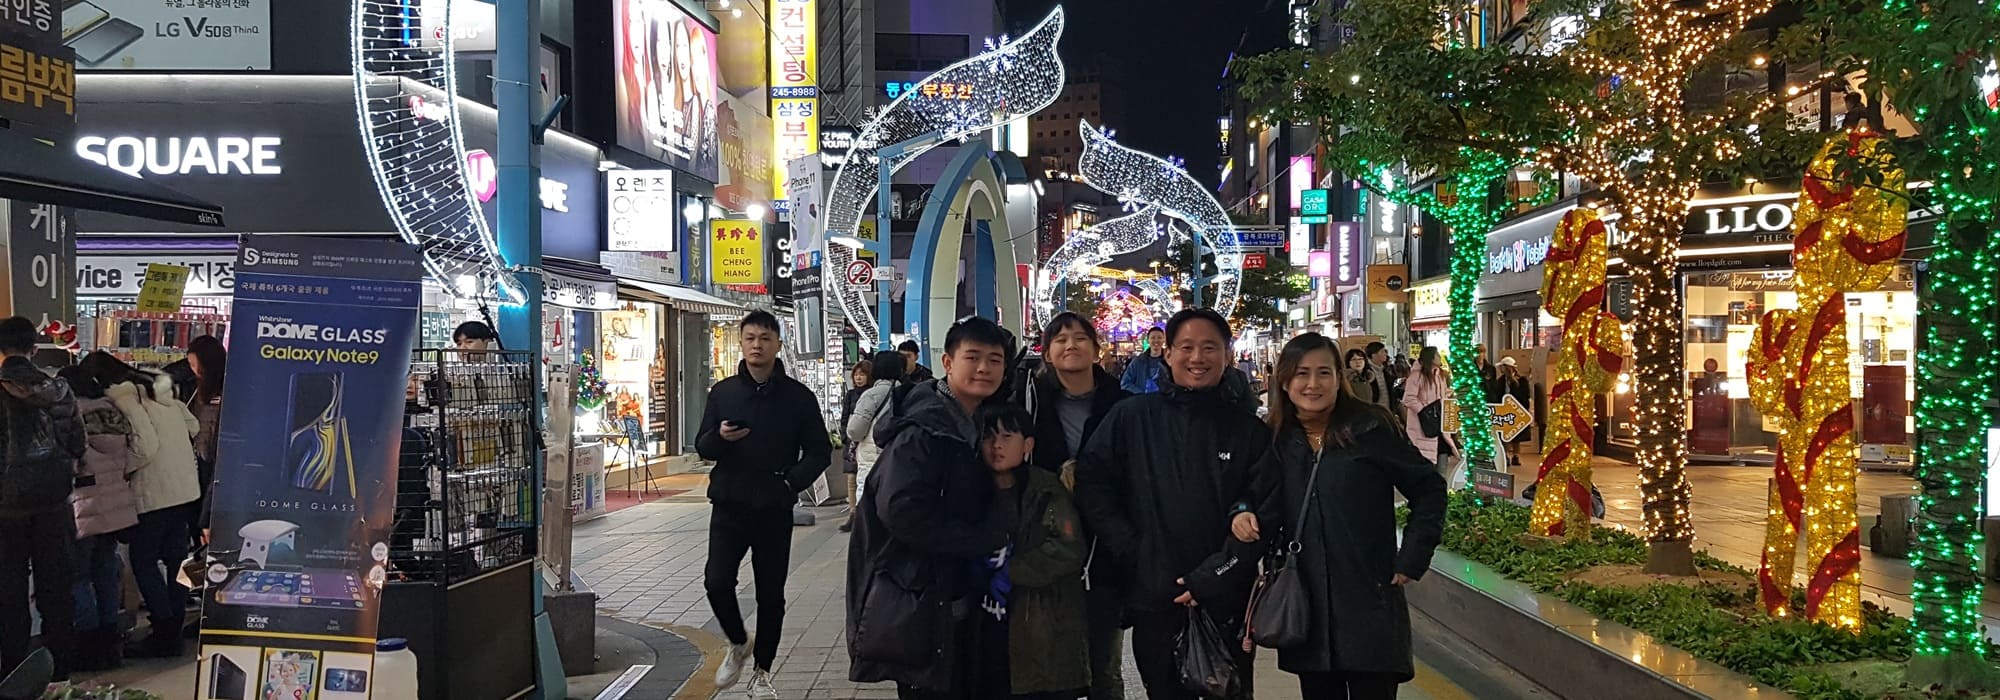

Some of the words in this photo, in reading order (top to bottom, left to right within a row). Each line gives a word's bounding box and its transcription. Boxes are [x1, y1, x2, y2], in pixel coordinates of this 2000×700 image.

[155, 22, 180, 37] LG
[232, 26, 259, 34] ThinQ
[1, 44, 74, 115] 름부착
[772, 87, 815, 97] 245-8988
[778, 102, 813, 117] 삼성
[76, 136, 282, 179] SQUARE
[614, 177, 664, 192] 오렌즈
[715, 227, 758, 241] 美珍香
[1754, 235, 1783, 243] THE
[261, 258, 299, 266] SAMSUNG
[257, 323, 318, 342] DOME
[321, 328, 386, 344] GLASS
[260, 345, 325, 365] Galaxy
[327, 349, 379, 364] Note9
[259, 500, 301, 509] DOME
[311, 503, 356, 512] GLASS
